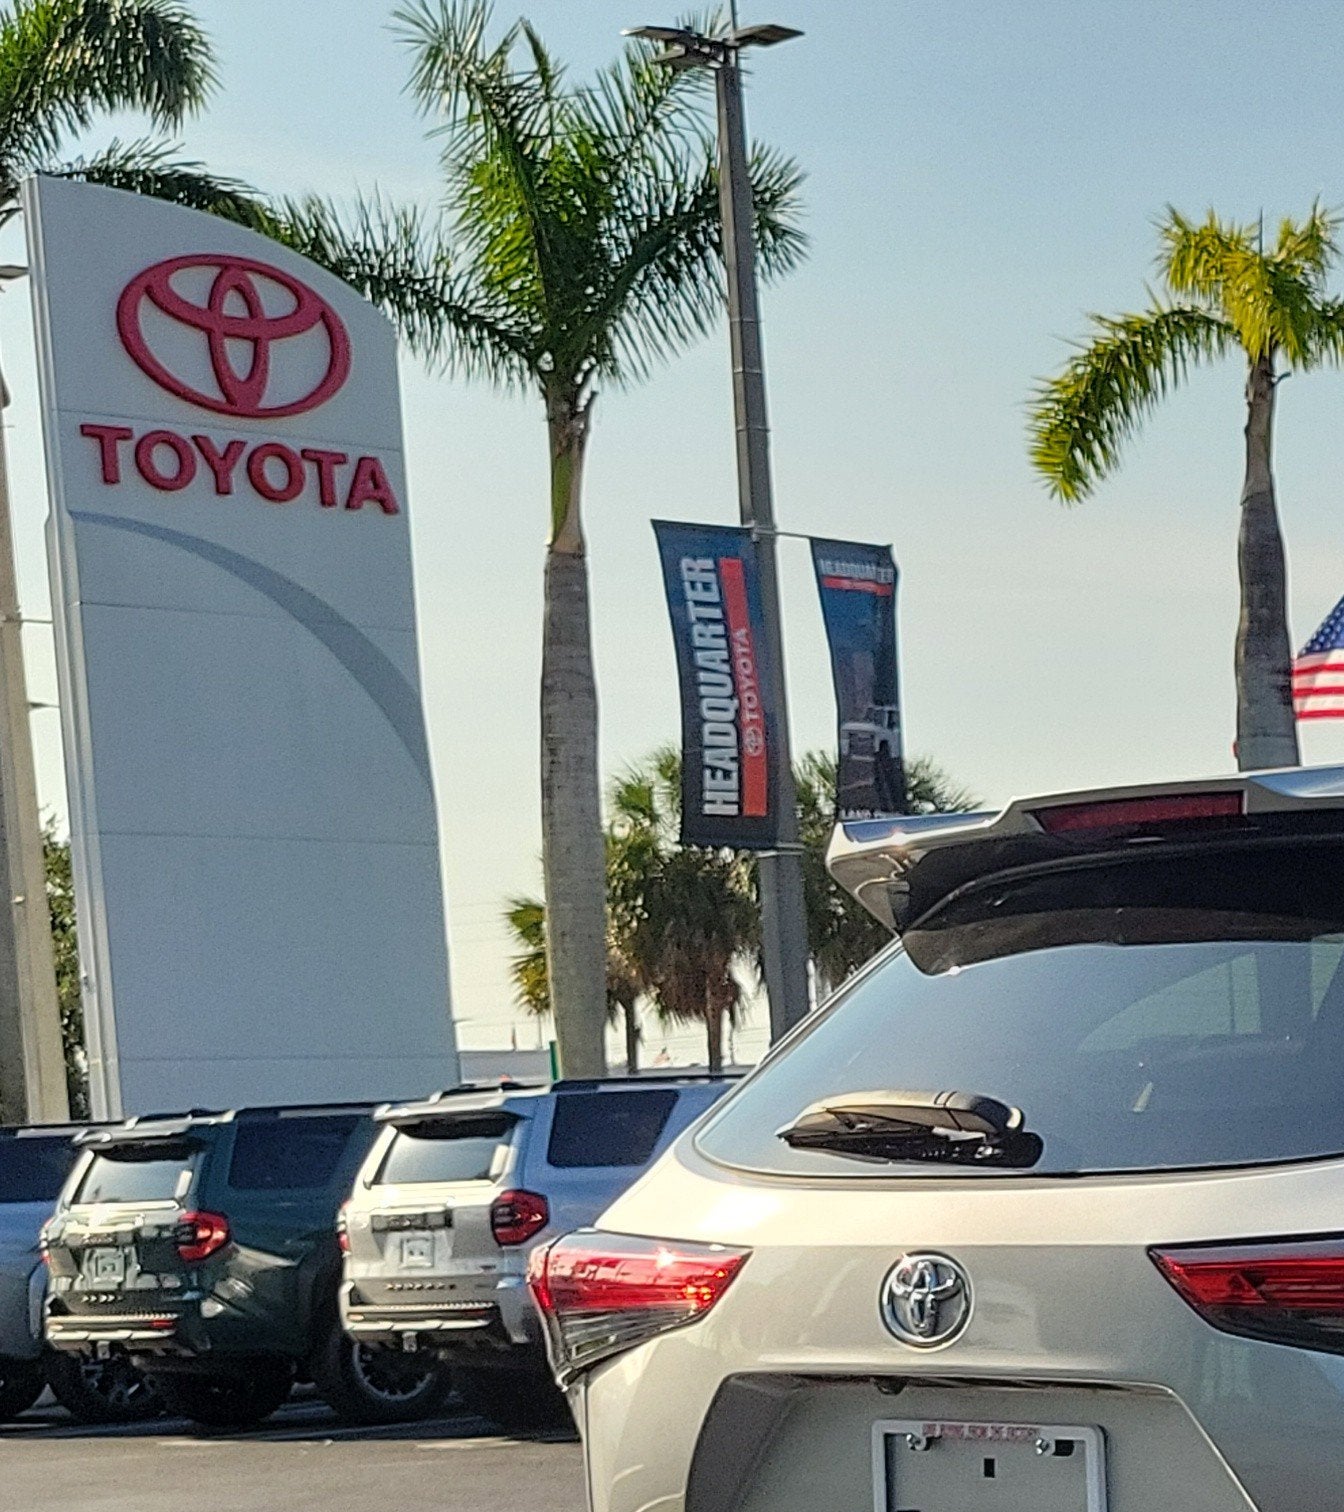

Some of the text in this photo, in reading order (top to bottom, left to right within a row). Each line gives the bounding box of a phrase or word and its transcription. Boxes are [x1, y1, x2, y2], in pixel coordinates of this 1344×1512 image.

[80, 424, 400, 515] TOYOTA
[682, 558, 739, 816] HEADQUARTER
[734, 628, 762, 721] TOYOTA
